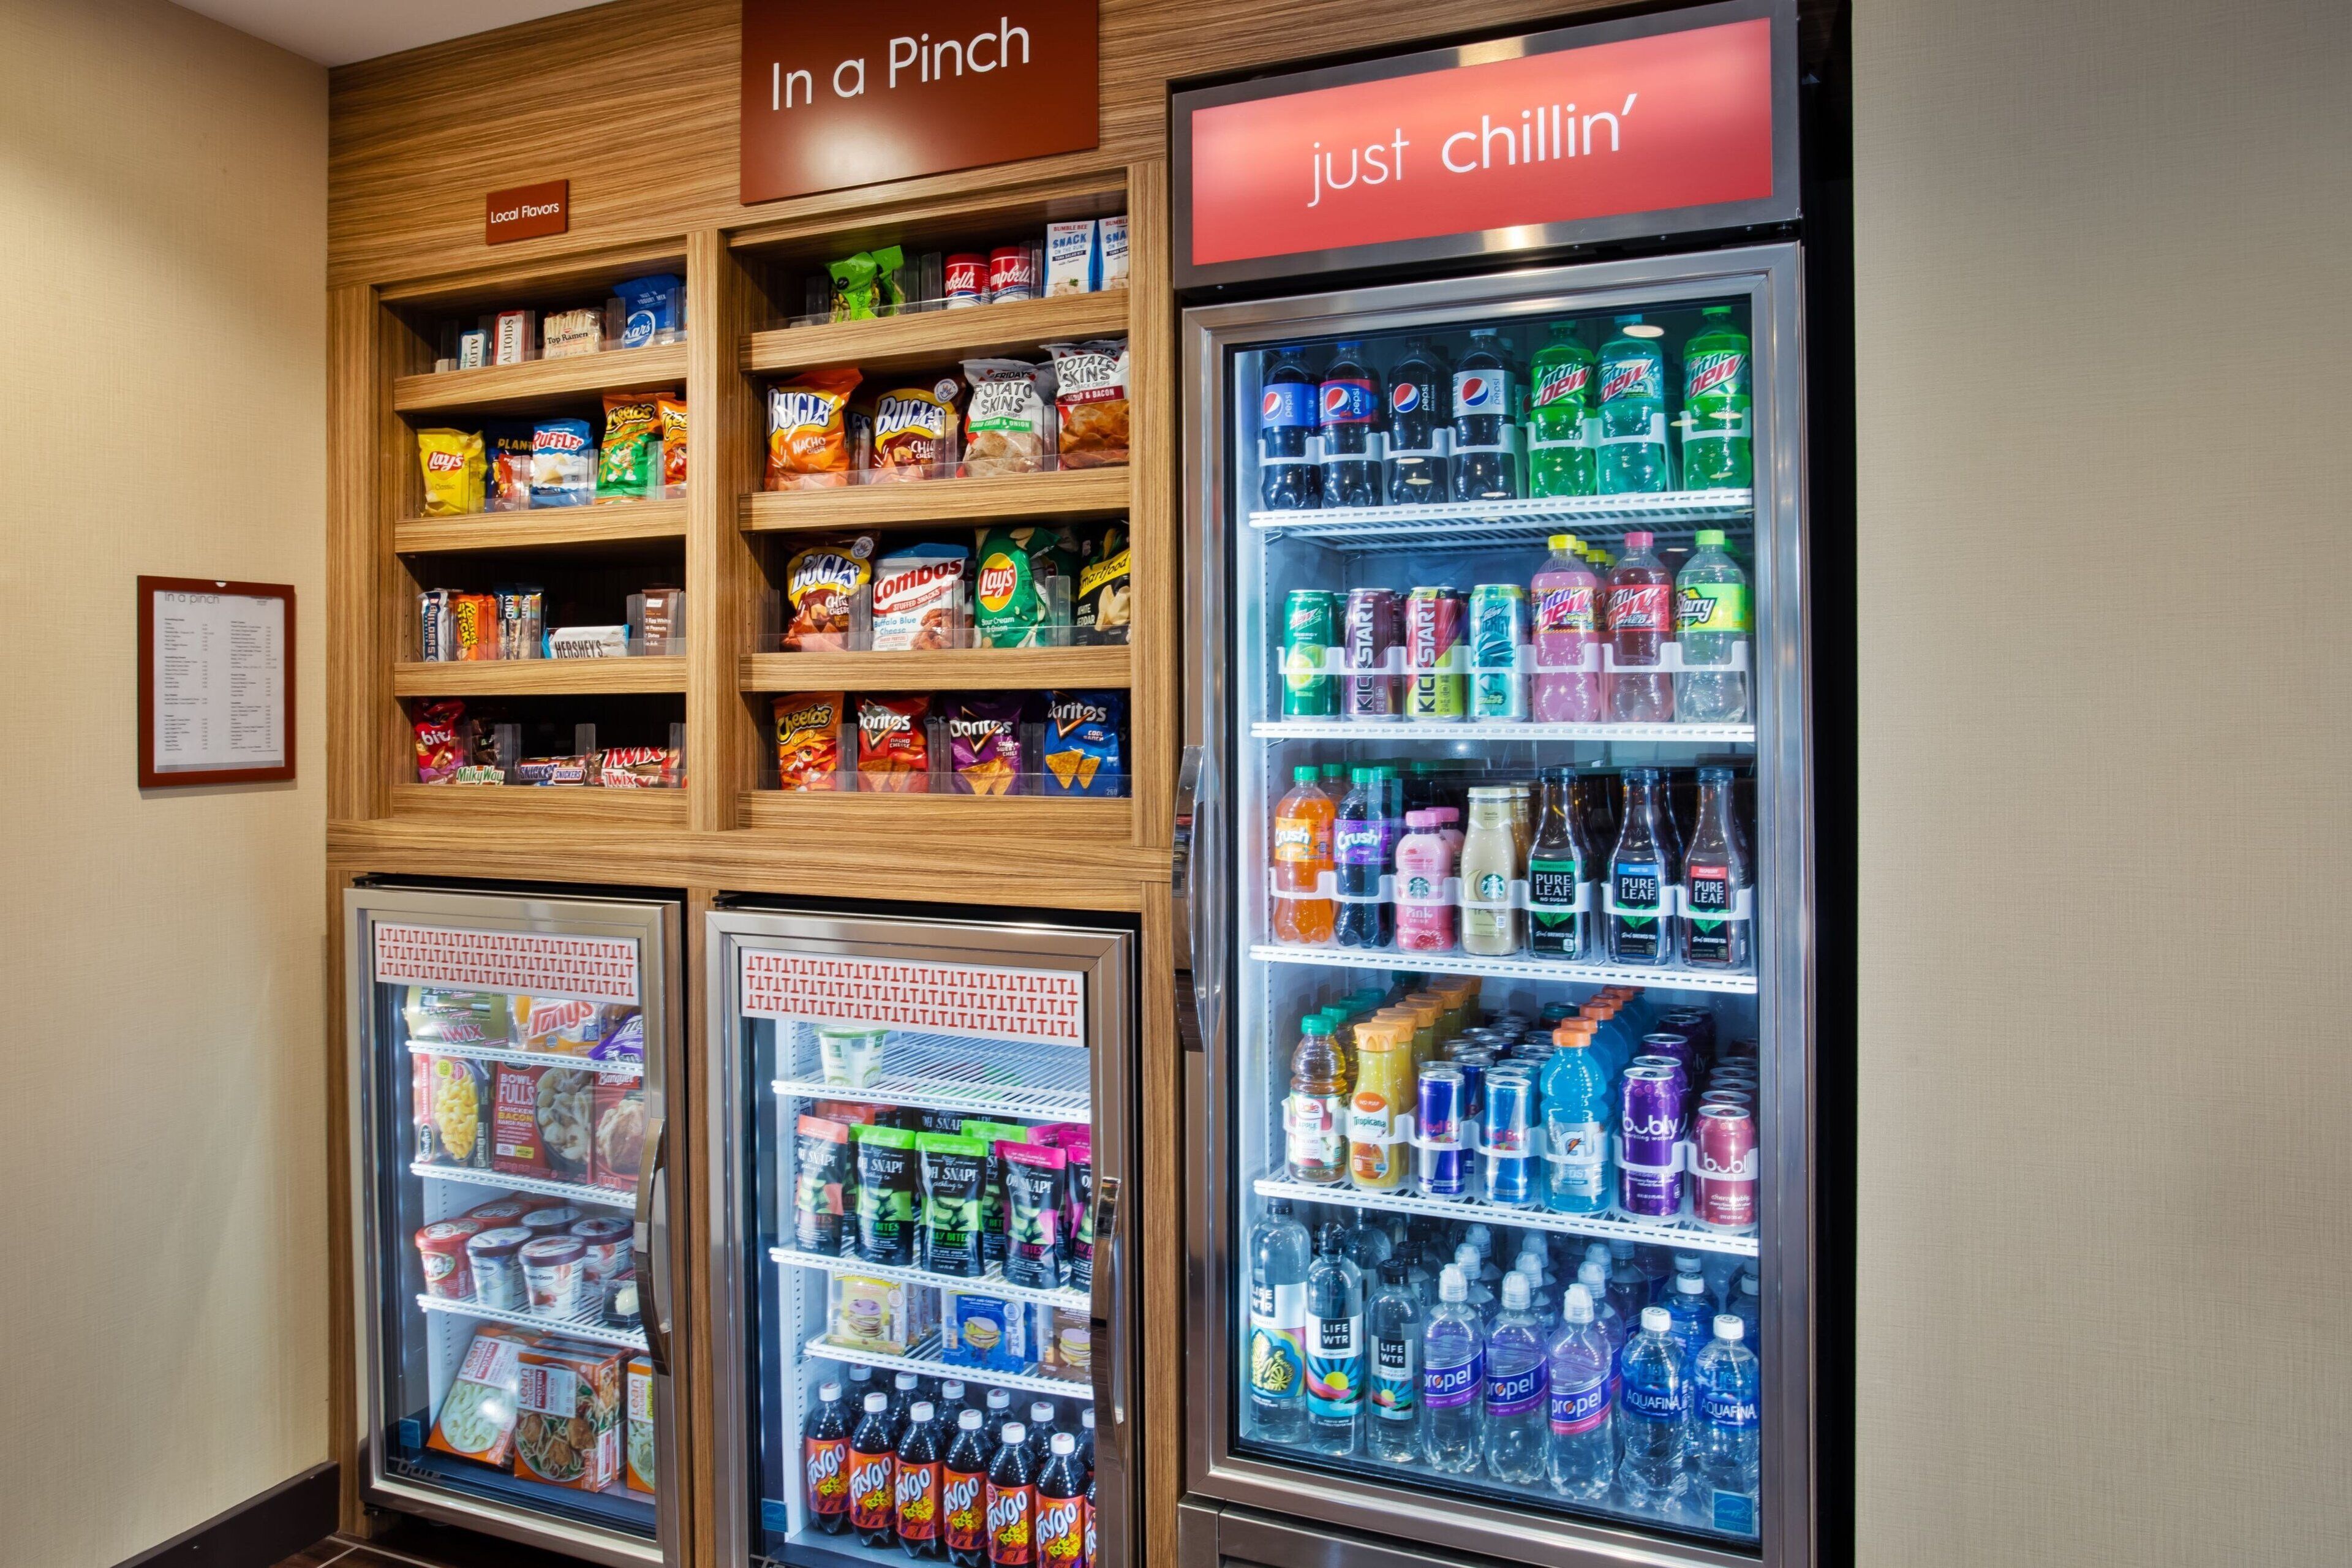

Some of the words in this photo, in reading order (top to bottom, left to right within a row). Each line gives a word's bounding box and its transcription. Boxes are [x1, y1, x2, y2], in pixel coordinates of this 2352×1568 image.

[773, 62, 812, 110] In
[834, 58, 864, 98] a
[889, 17, 1030, 89] Pinch
[1306, 127, 1410, 208] just
[1441, 92, 1638, 174] chillin'
[491, 207, 518, 224] Local
[522, 203, 559, 218] Flavors
[1053, 233, 1087, 248] SNACK
[502, 318, 513, 363] ALTOIDS
[562, 332, 588, 342] Ramen
[1057, 355, 1118, 376] POTATO
[1063, 367, 1110, 388] SKINS
[974, 382, 1032, 399] POTATO
[1092, 389, 1115, 398] BACON
[1420, 384, 1430, 411] pepsi
[1492, 378, 1502, 405] pepsi
[981, 396, 1025, 415] SKINS
[1285, 391, 1294, 418] pepsi
[1352, 387, 1360, 415] pepsi
[768, 388, 834, 437] BUGLES
[875, 396, 946, 436] BUGLES
[533, 430, 584, 451] RUFFLES
[793, 437, 826, 454] NACHO
[429, 452, 464, 471] Lay's
[791, 553, 861, 595] BUGLES
[874, 559, 963, 604] Combos
[980, 565, 1014, 598] Lay's
[190, 595, 220, 605] pinch
[505, 595, 514, 619] KIND
[522, 595, 532, 619] KIND
[892, 600, 916, 611] STUFFED
[917, 589, 941, 603] SNACKS
[1676, 594, 1716, 623] Starry
[874, 618, 897, 628] Buffalo
[900, 616, 917, 624] Blue
[554, 640, 603, 658] HERSHEY'S
[859, 712, 911, 731] Doritos
[1048, 701, 1107, 722] Doritos
[777, 706, 832, 743] Cheetos
[949, 720, 1014, 737] Doritos
[603, 747, 665, 768] TWIX
[458, 767, 482, 785] Milky
[483, 766, 503, 784] Way
[555, 770, 581, 779] SNICKERS
[1336, 829, 1381, 850] Crush
[1536, 874, 1572, 885] PURE
[1622, 878, 1655, 888] PURE
[1695, 881, 1724, 892] PURE
[1406, 907, 1433, 918] Pink
[499, 1084, 535, 1105] FULLS
[498, 1112, 533, 1122] BACON
[499, 1106, 533, 1115] CHICKEN
[1353, 1116, 1387, 1128] Tropicana
[1623, 1110, 1678, 1136] bubly
[807, 1150, 837, 1167] SNAP!
[871, 1159, 905, 1174] SNAP!
[925, 1168, 938, 1180] OH
[943, 1169, 978, 1182] SNAP!
[1006, 1173, 1017, 1186] OH
[1020, 1178, 1054, 1193] SNAP!
[875, 1222, 900, 1232] BITES
[947, 1233, 971, 1243] BITES
[1022, 1245, 1044, 1254] BITES
[1254, 1286, 1273, 1299] LIFE
[1253, 1298, 1273, 1313] WTR
[1322, 1323, 1349, 1333] LIFE
[1322, 1335, 1349, 1345] WTR
[1380, 1343, 1403, 1354] LIFE
[461, 1340, 484, 1376] Lean
[1380, 1353, 1404, 1364] WTR
[520, 1367, 529, 1405] Lean
[630, 1379, 641, 1417] Lean
[1551, 1386, 1602, 1417] propel
[1626, 1391, 1682, 1411] AQUAFINA
[1702, 1400, 1757, 1419] AQUAFINA
[807, 1443, 845, 1493] Faygo
[850, 1457, 892, 1507] Faygo
[987, 1490, 1027, 1540] Faygo
[1036, 1502, 1077, 1552] Faygo
